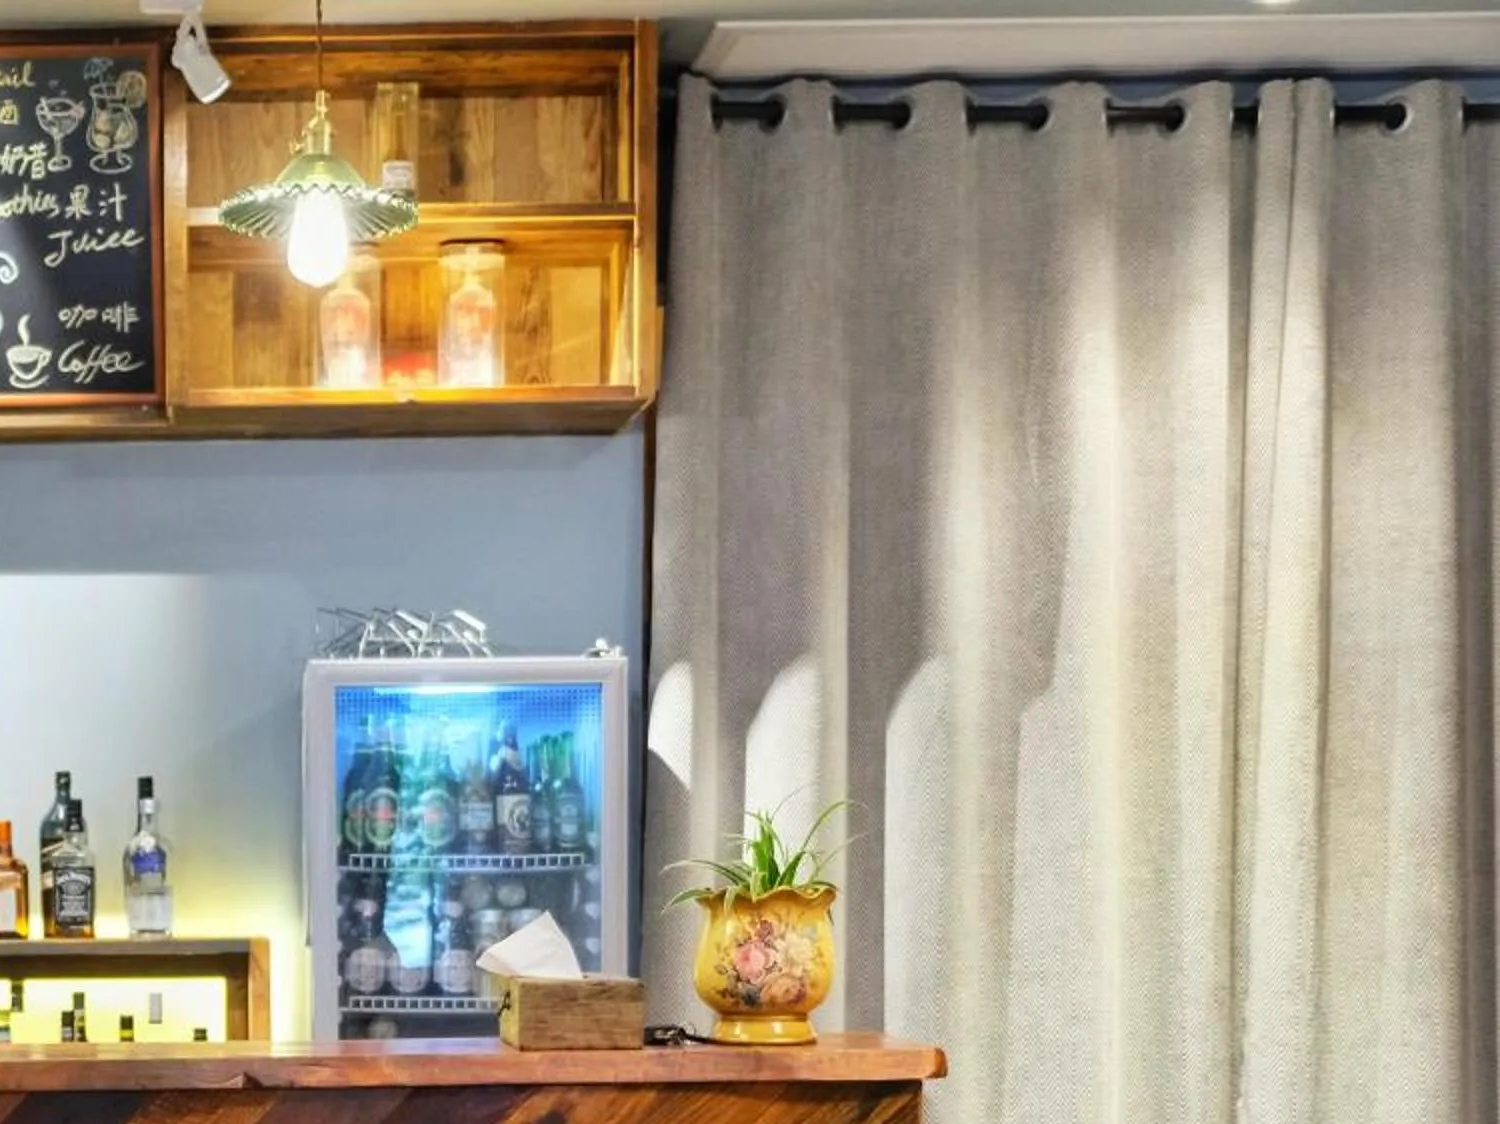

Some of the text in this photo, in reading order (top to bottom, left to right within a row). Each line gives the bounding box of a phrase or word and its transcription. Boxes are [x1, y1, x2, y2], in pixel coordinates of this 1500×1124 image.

[64, 183, 128, 222] 果汁
[43, 228, 145, 268] Juice
[58, 301, 141, 333] 咖啡
[58, 340, 146, 384] Coffee
